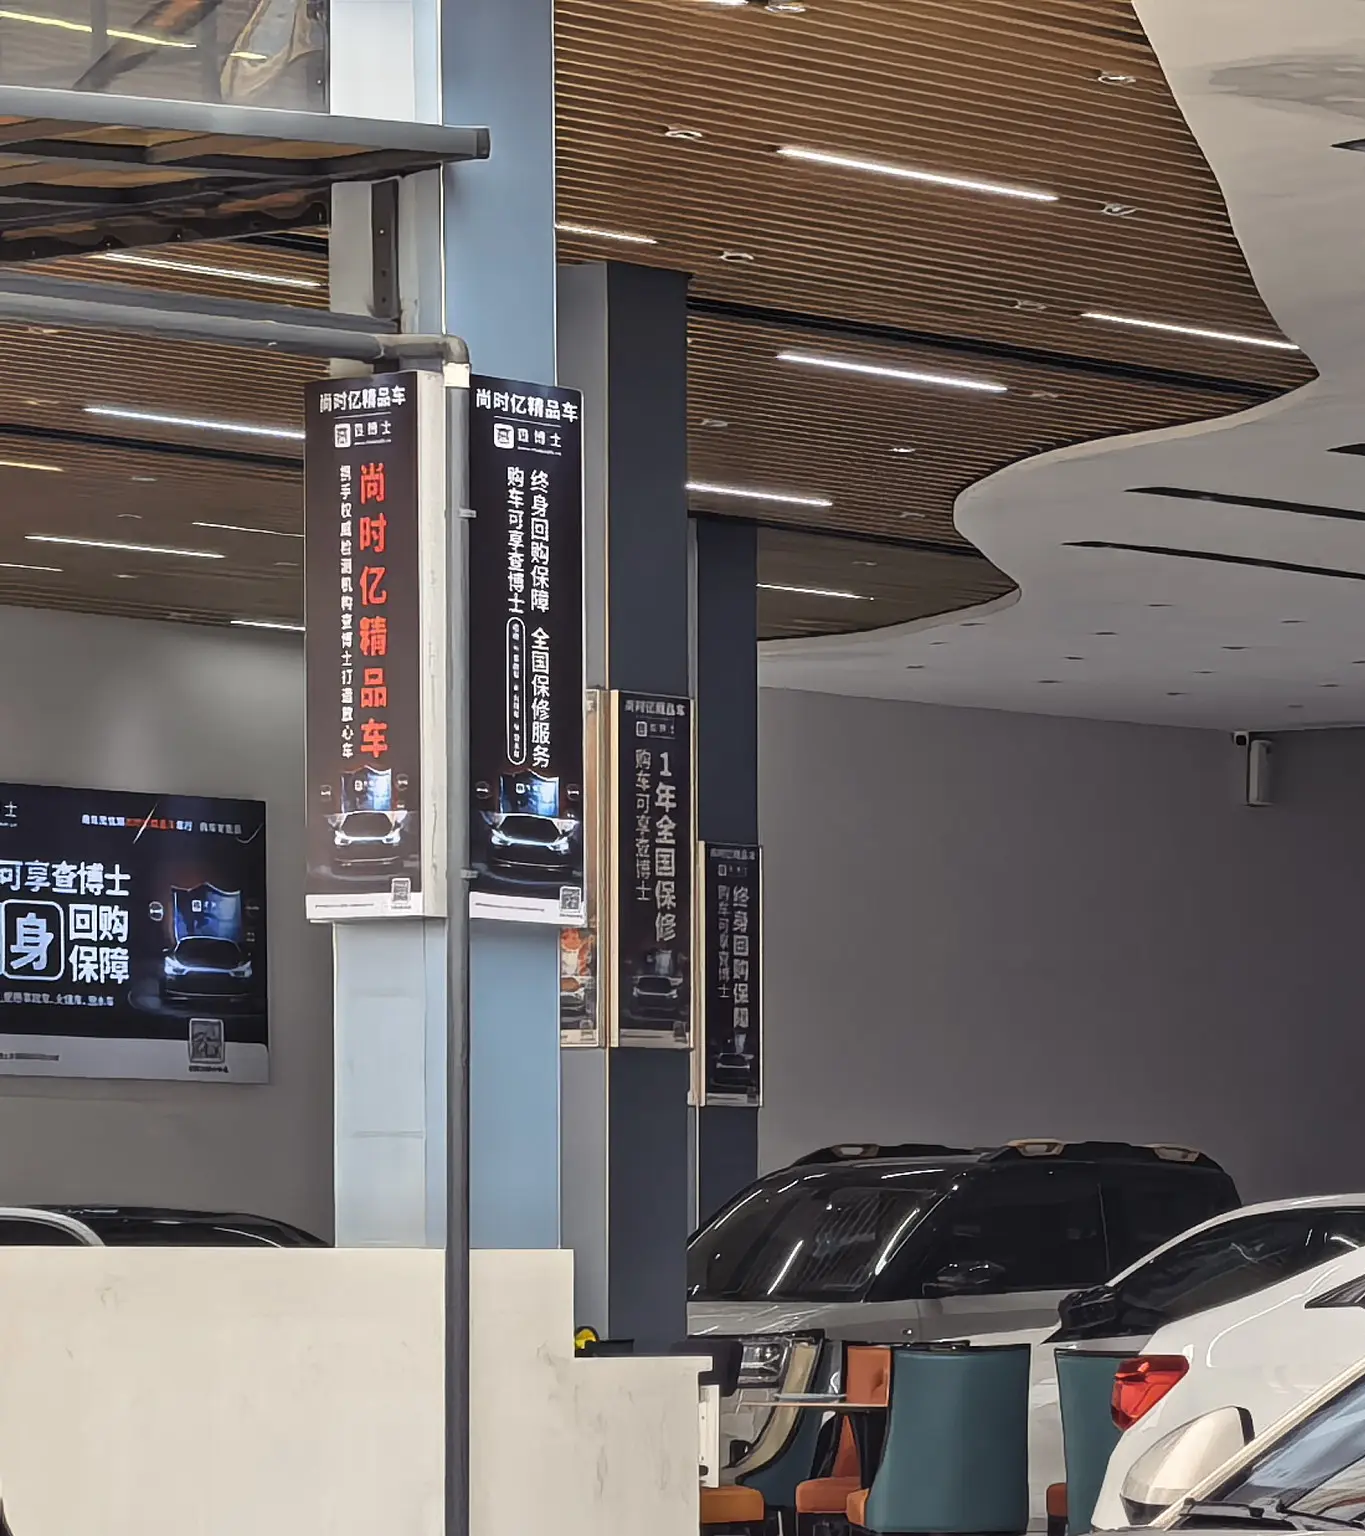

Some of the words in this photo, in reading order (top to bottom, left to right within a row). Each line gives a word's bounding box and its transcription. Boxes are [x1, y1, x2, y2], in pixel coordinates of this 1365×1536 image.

[320, 385, 406, 413] 尚时亿精品车
[476, 388, 578, 423] 尚时亿精品车
[507, 466, 525, 614] 购车可享查博士
[530, 469, 549, 613] 终身回购保障
[359, 462, 389, 757] 尚时亿精品车
[530, 626, 550, 768] 全国保修服务
[655, 752, 677, 942] 1年全国保修
[0, 860, 131, 896] 可享查博士
[10, 912, 54, 970] 身
[69, 903, 129, 942] 回购
[68, 946, 130, 984] 保障
